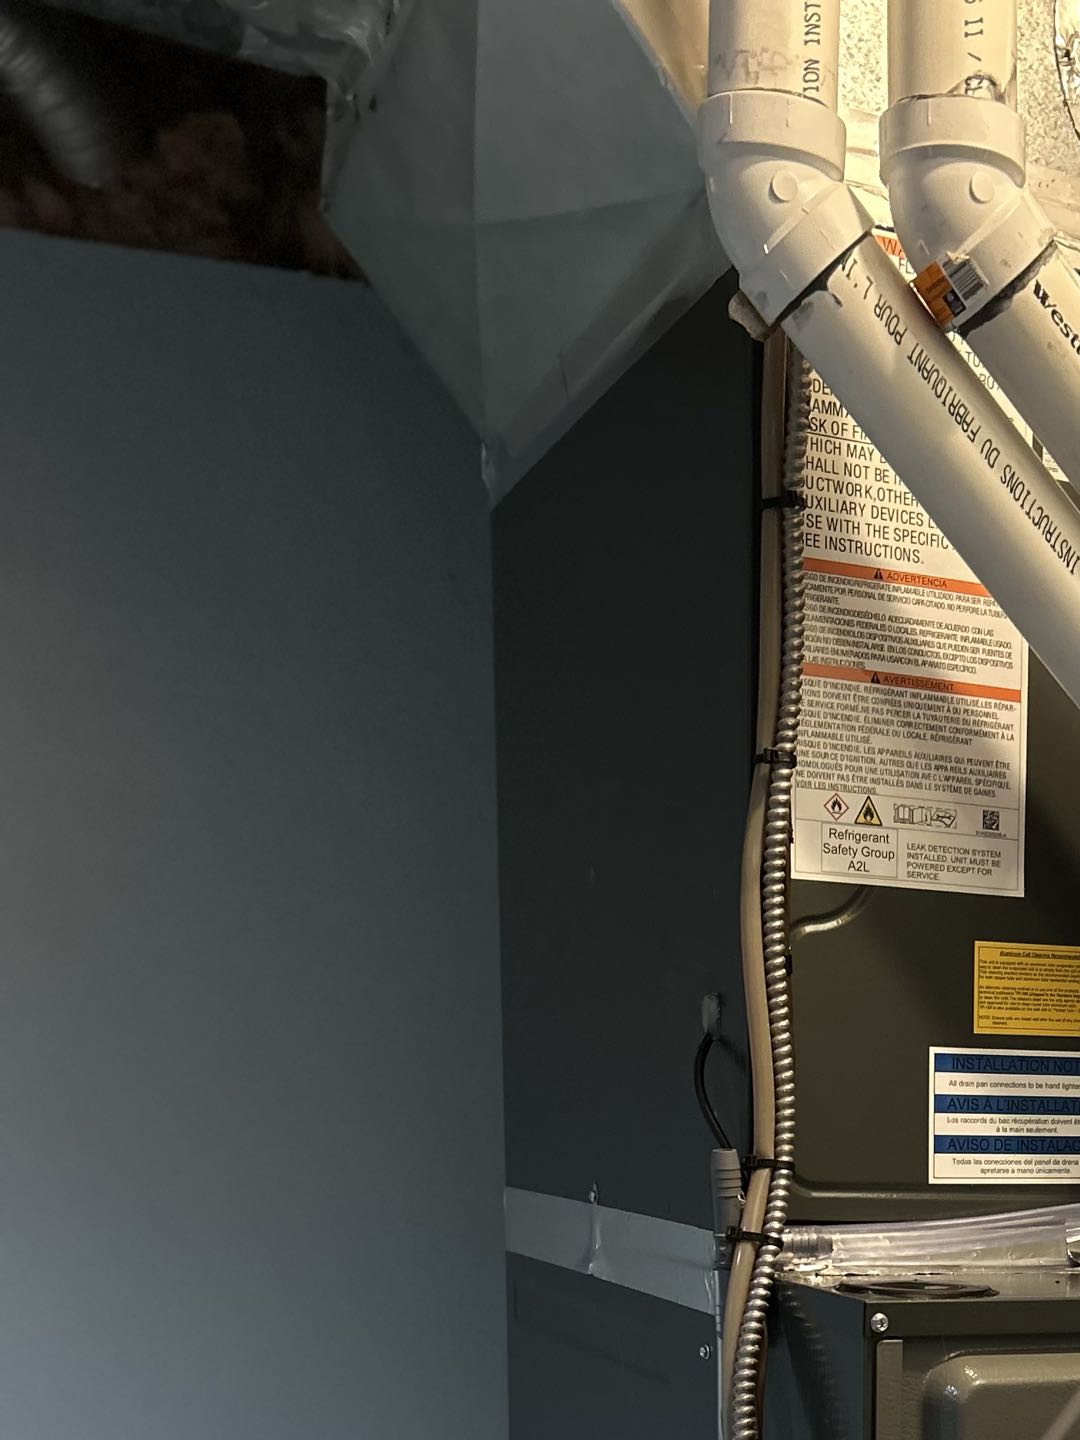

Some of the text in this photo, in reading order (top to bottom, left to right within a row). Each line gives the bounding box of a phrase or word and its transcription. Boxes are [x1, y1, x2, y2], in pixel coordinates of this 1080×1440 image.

[873, 292, 907, 344] POUR
[907, 342, 982, 444] FABRIQUANT
[831, 419, 848, 434] OF
[846, 442, 874, 462] MAY
[980, 438, 1000, 469] DU
[843, 463, 869, 480] NOT
[874, 468, 890, 484] BE
[870, 505, 924, 528] DEVICES
[1000, 464, 1080, 576] INSTRUCTIONS
[826, 517, 860, 536] WITH
[865, 522, 889, 539] THE
[824, 535, 925, 564] INSTRUCTIONS.
[887, 572, 948, 588] ADVERTENCIA
[884, 674, 955, 691] AVERTISSEMENT
[828, 828, 890, 844] Refrigerant
[823, 843, 895, 862] Safety Group
[907, 843, 1001, 858] LEAK DETECTION SYSTEM
[848, 860, 870, 873] A2L
[907, 862, 993, 876] POWERED EXCEPT FOR
[951, 856, 968, 865] UNIT
[970, 857, 989, 866] MUST
[992, 859, 1000, 867] BE
[952, 1056, 1050, 1072] INSTALLATION
[948, 1079, 956, 1088] All
[958, 1079, 975, 1088] drain
[976, 1081, 988, 1090] pan
[989, 1080, 1027, 1090] connections
[1035, 1081, 1043, 1090] be
[1045, 1081, 1060, 1090] hand
[947, 1098, 980, 1111] AVIS
[947, 1137, 990, 1151] AVISO
[993, 1138, 1013, 1151] DE
